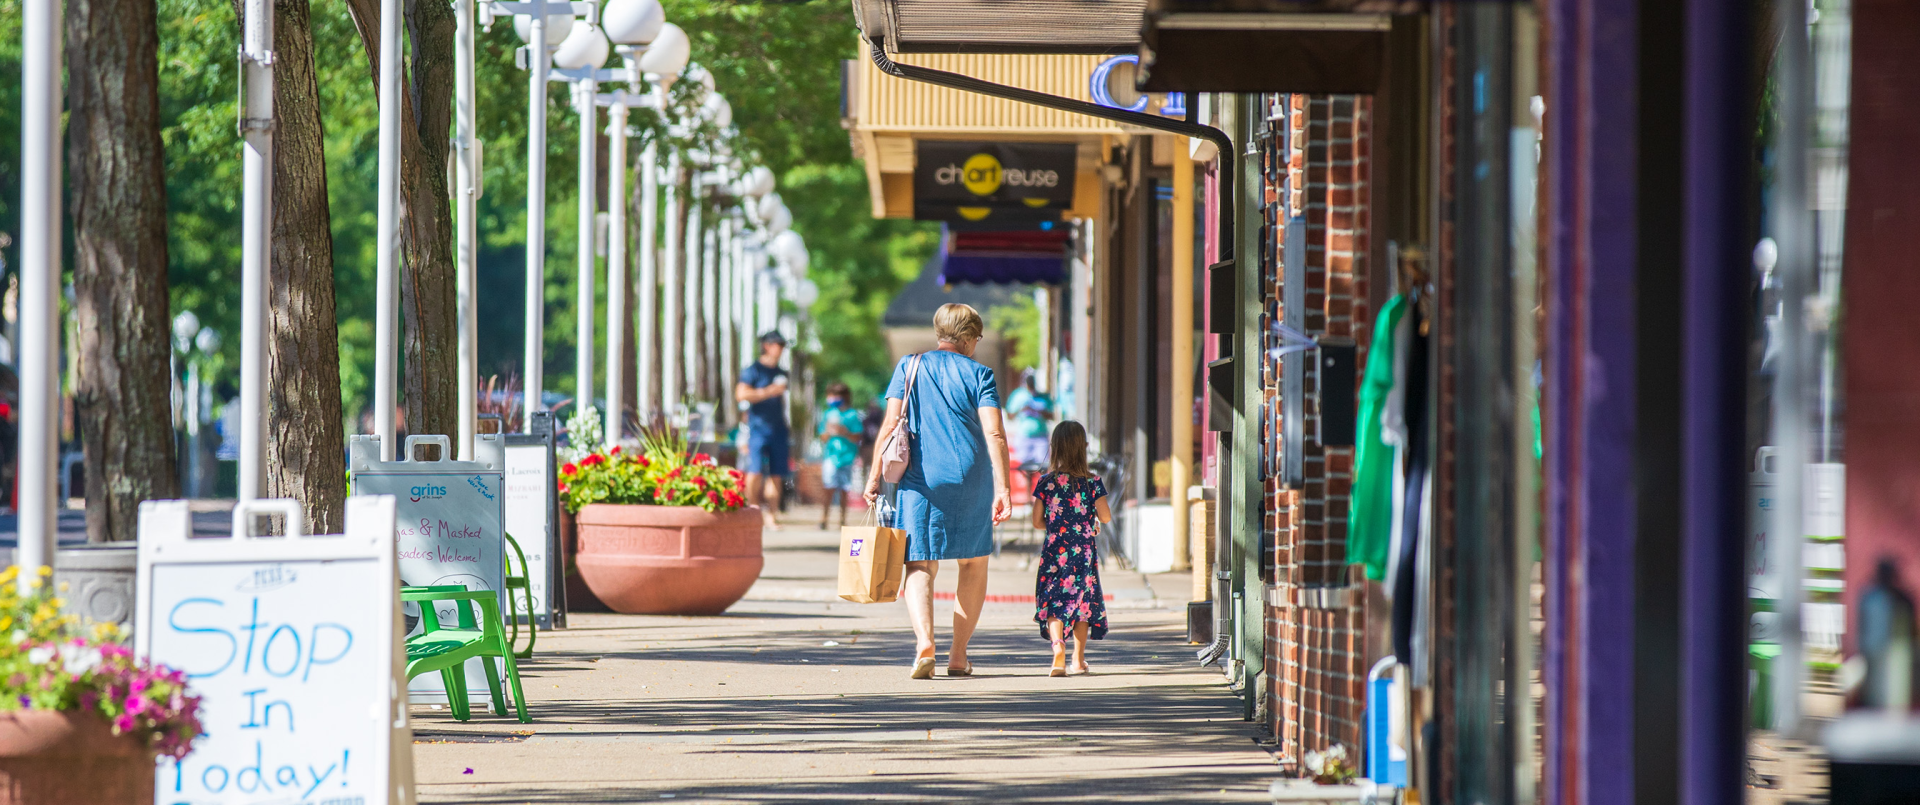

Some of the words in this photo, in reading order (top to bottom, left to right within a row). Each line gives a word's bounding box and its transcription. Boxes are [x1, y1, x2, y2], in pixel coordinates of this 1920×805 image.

[934, 163, 1059, 187] chartreuse
[410, 483, 447, 502] grins
[420, 518, 433, 538] &
[438, 519, 482, 539] Masked
[437, 545, 482, 563] Welcome!
[168, 597, 353, 683] Stop
[239, 688, 295, 732] In
